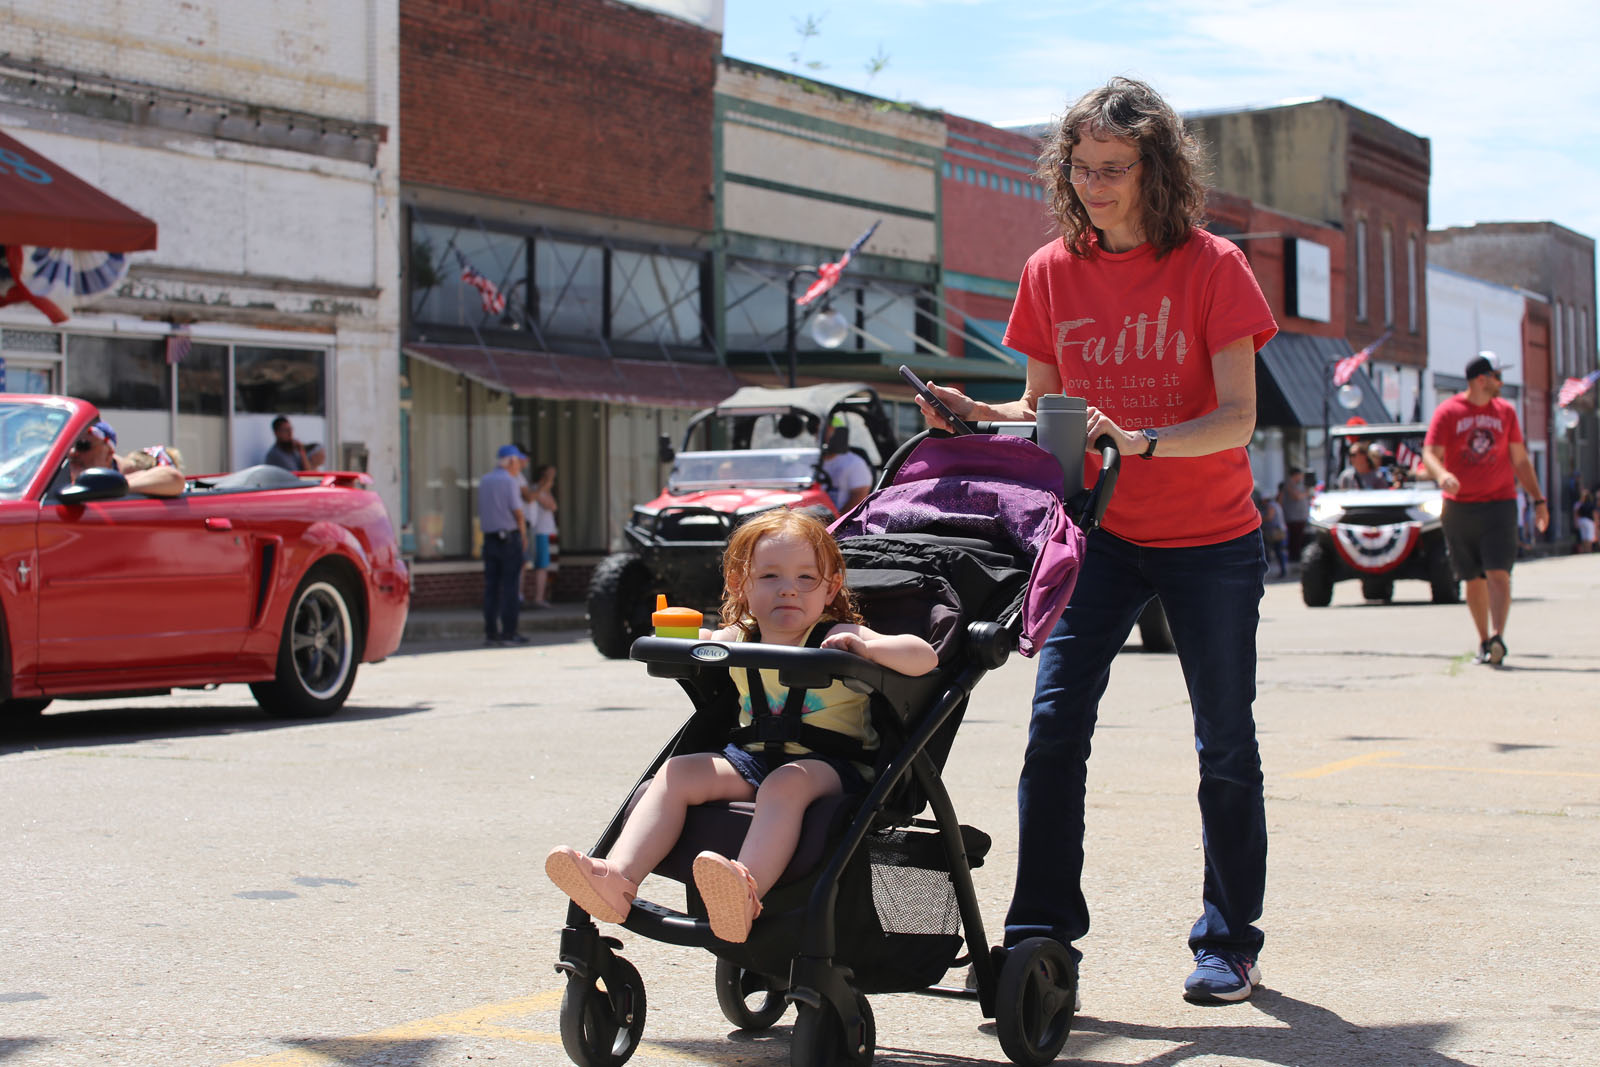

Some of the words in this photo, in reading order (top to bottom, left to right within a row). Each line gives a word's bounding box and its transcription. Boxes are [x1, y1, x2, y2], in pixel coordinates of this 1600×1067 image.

[1055, 296, 1195, 365] Faith
[1120, 376, 1156, 389] live
[1162, 373, 1180, 387] it
[1121, 394, 1160, 408] talk
[1166, 392, 1184, 407] it
[1117, 416, 1155, 428] loan
[1161, 413, 1179, 425] it
[697, 647, 726, 657] GRACO
